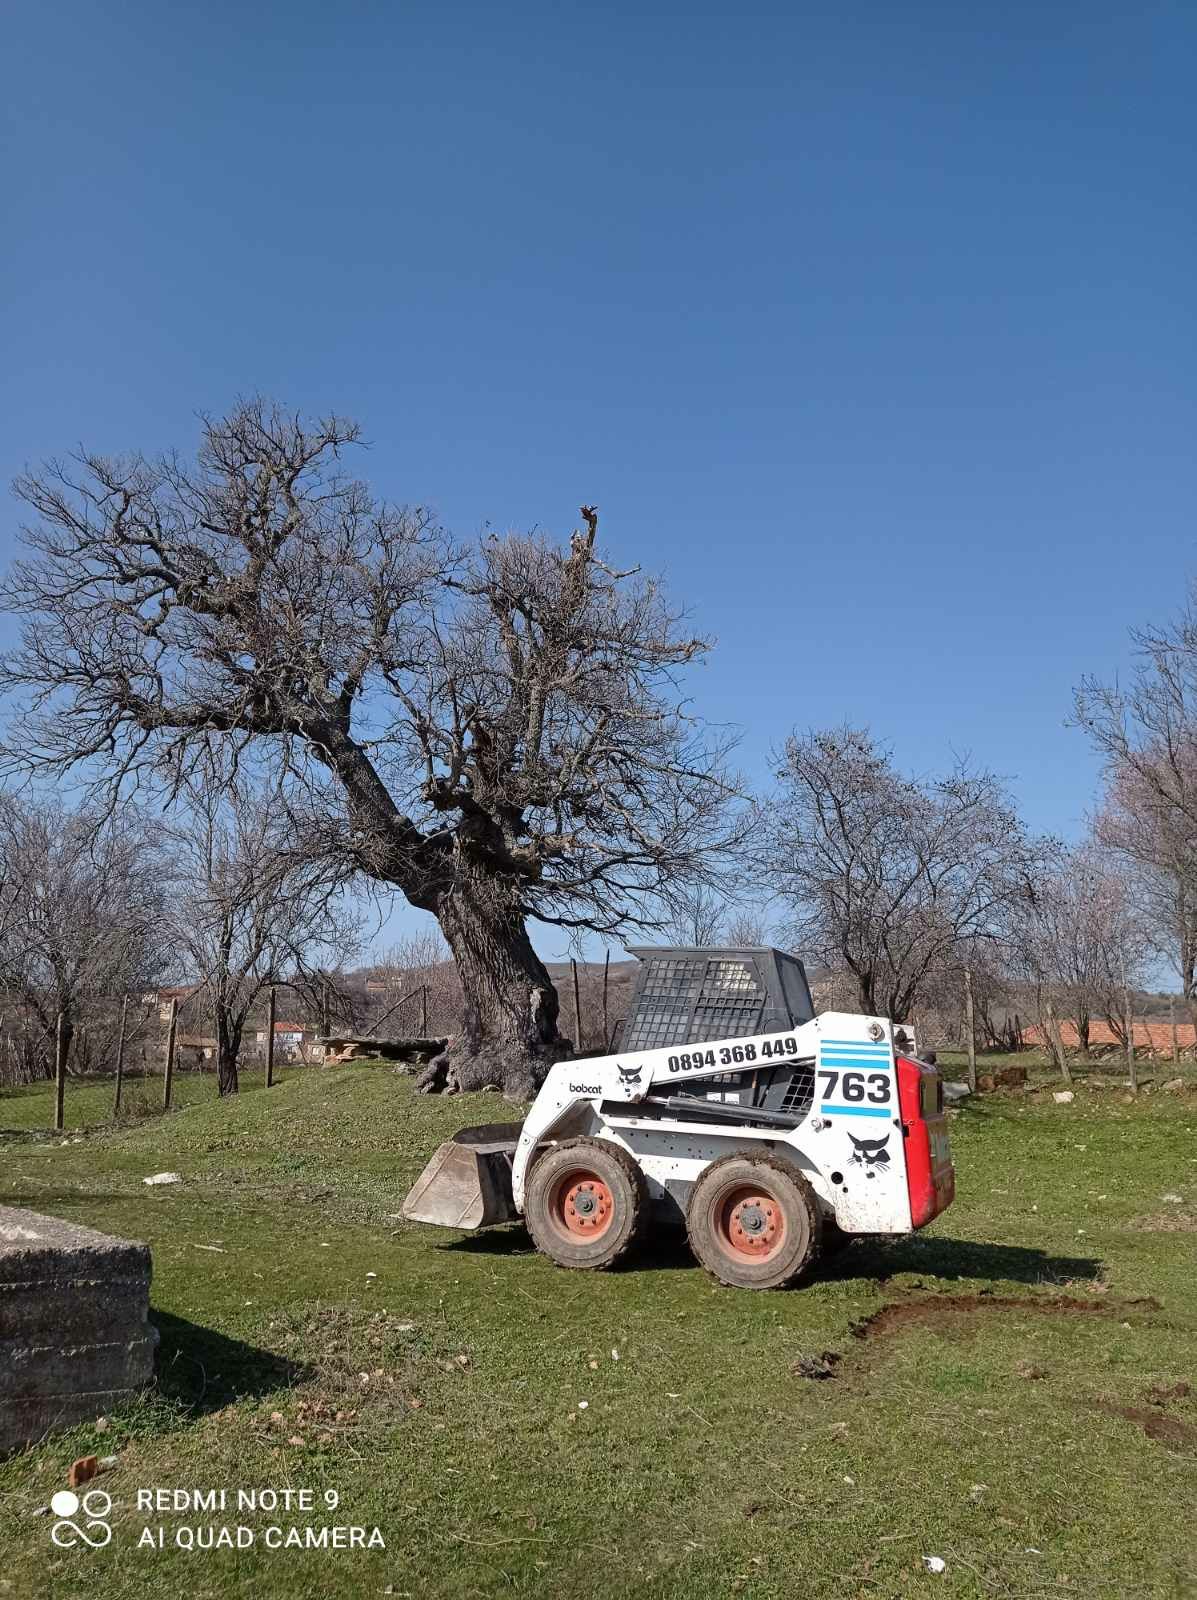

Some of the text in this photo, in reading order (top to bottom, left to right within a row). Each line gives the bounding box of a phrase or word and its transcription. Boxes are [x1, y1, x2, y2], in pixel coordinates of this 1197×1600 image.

[668, 1037, 798, 1073] 0894 368 449
[569, 1082, 602, 1095] bobcat
[818, 1070, 891, 1104] 763
